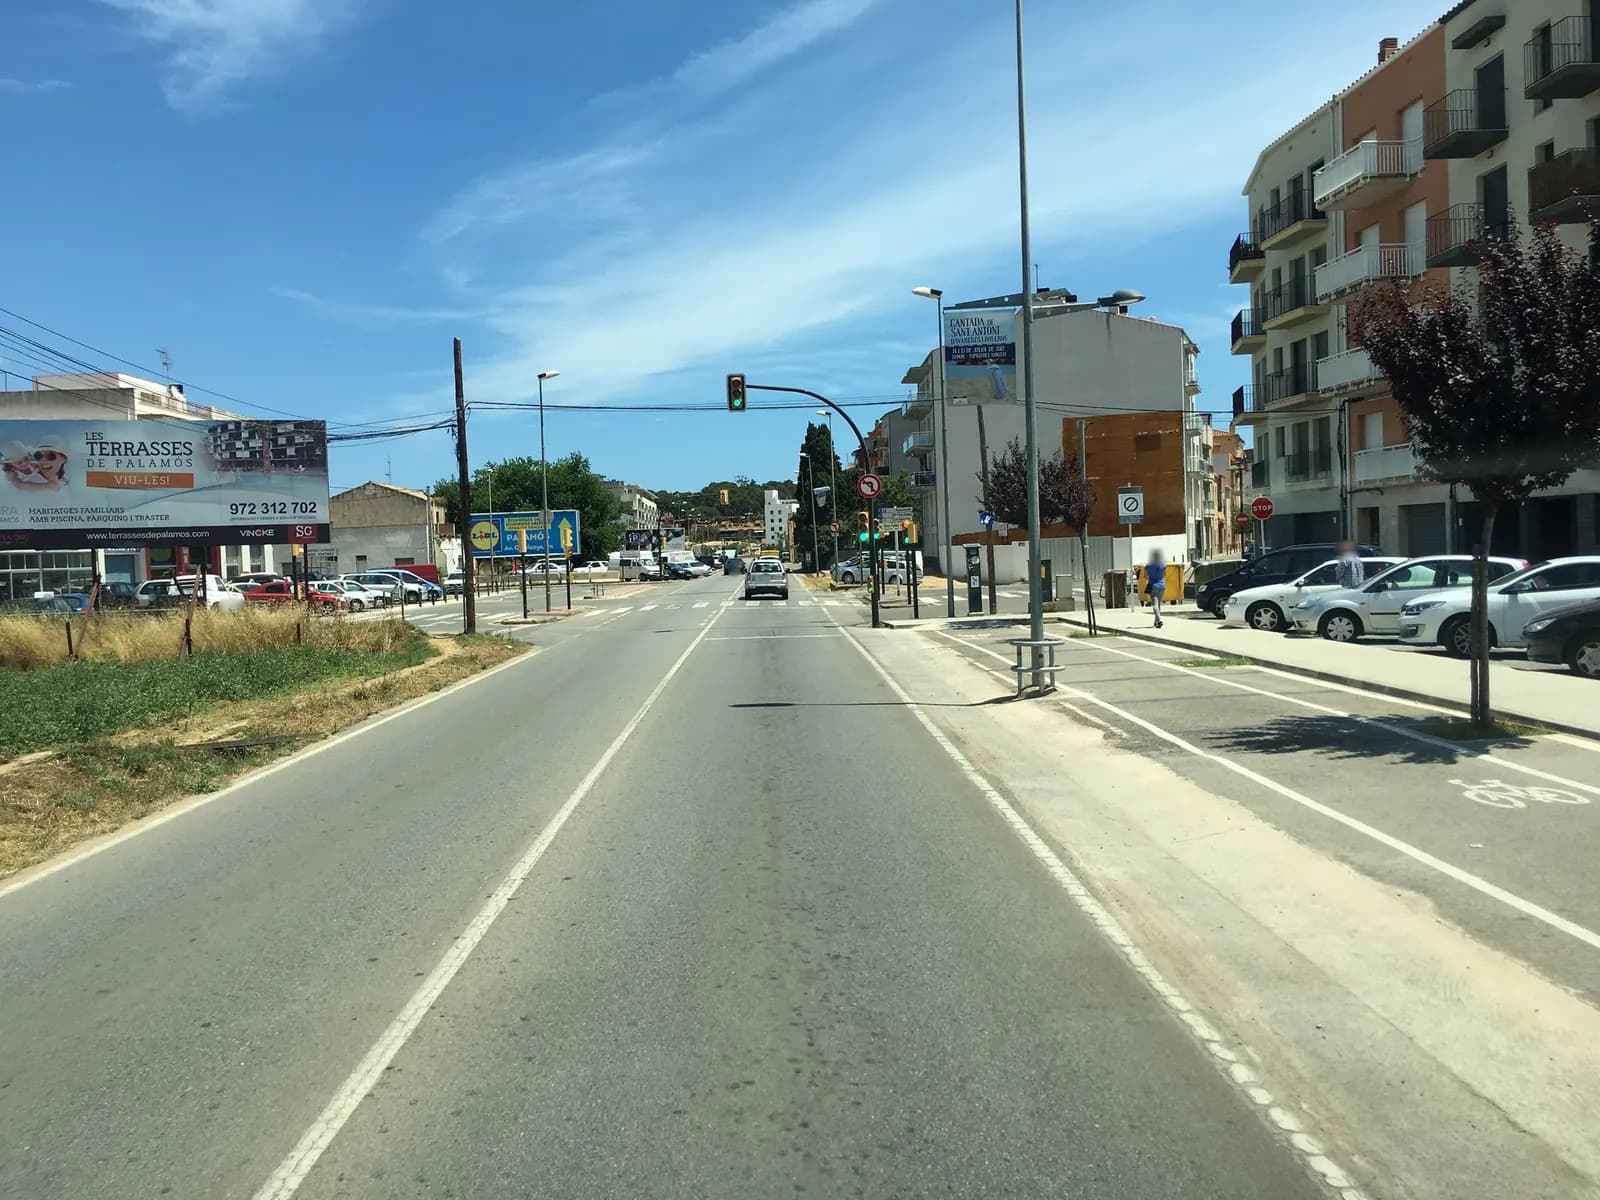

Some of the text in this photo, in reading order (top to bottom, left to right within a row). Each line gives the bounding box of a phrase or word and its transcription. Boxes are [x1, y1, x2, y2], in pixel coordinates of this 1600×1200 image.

[951, 325, 1000, 336] SANT ANTONI
[85, 432, 104, 441] LES
[86, 441, 194, 457] TERRASSES
[87, 456, 194, 469] DE PALAMÓS
[113, 475, 170, 485] VIU-LES!
[29, 507, 79, 515] HABITATGES
[230, 501, 318, 515] 972 312 702
[1253, 504, 1272, 512] STOP
[87, 525, 314, 540] www.terrassesdepalamos.com VINCKE SG
